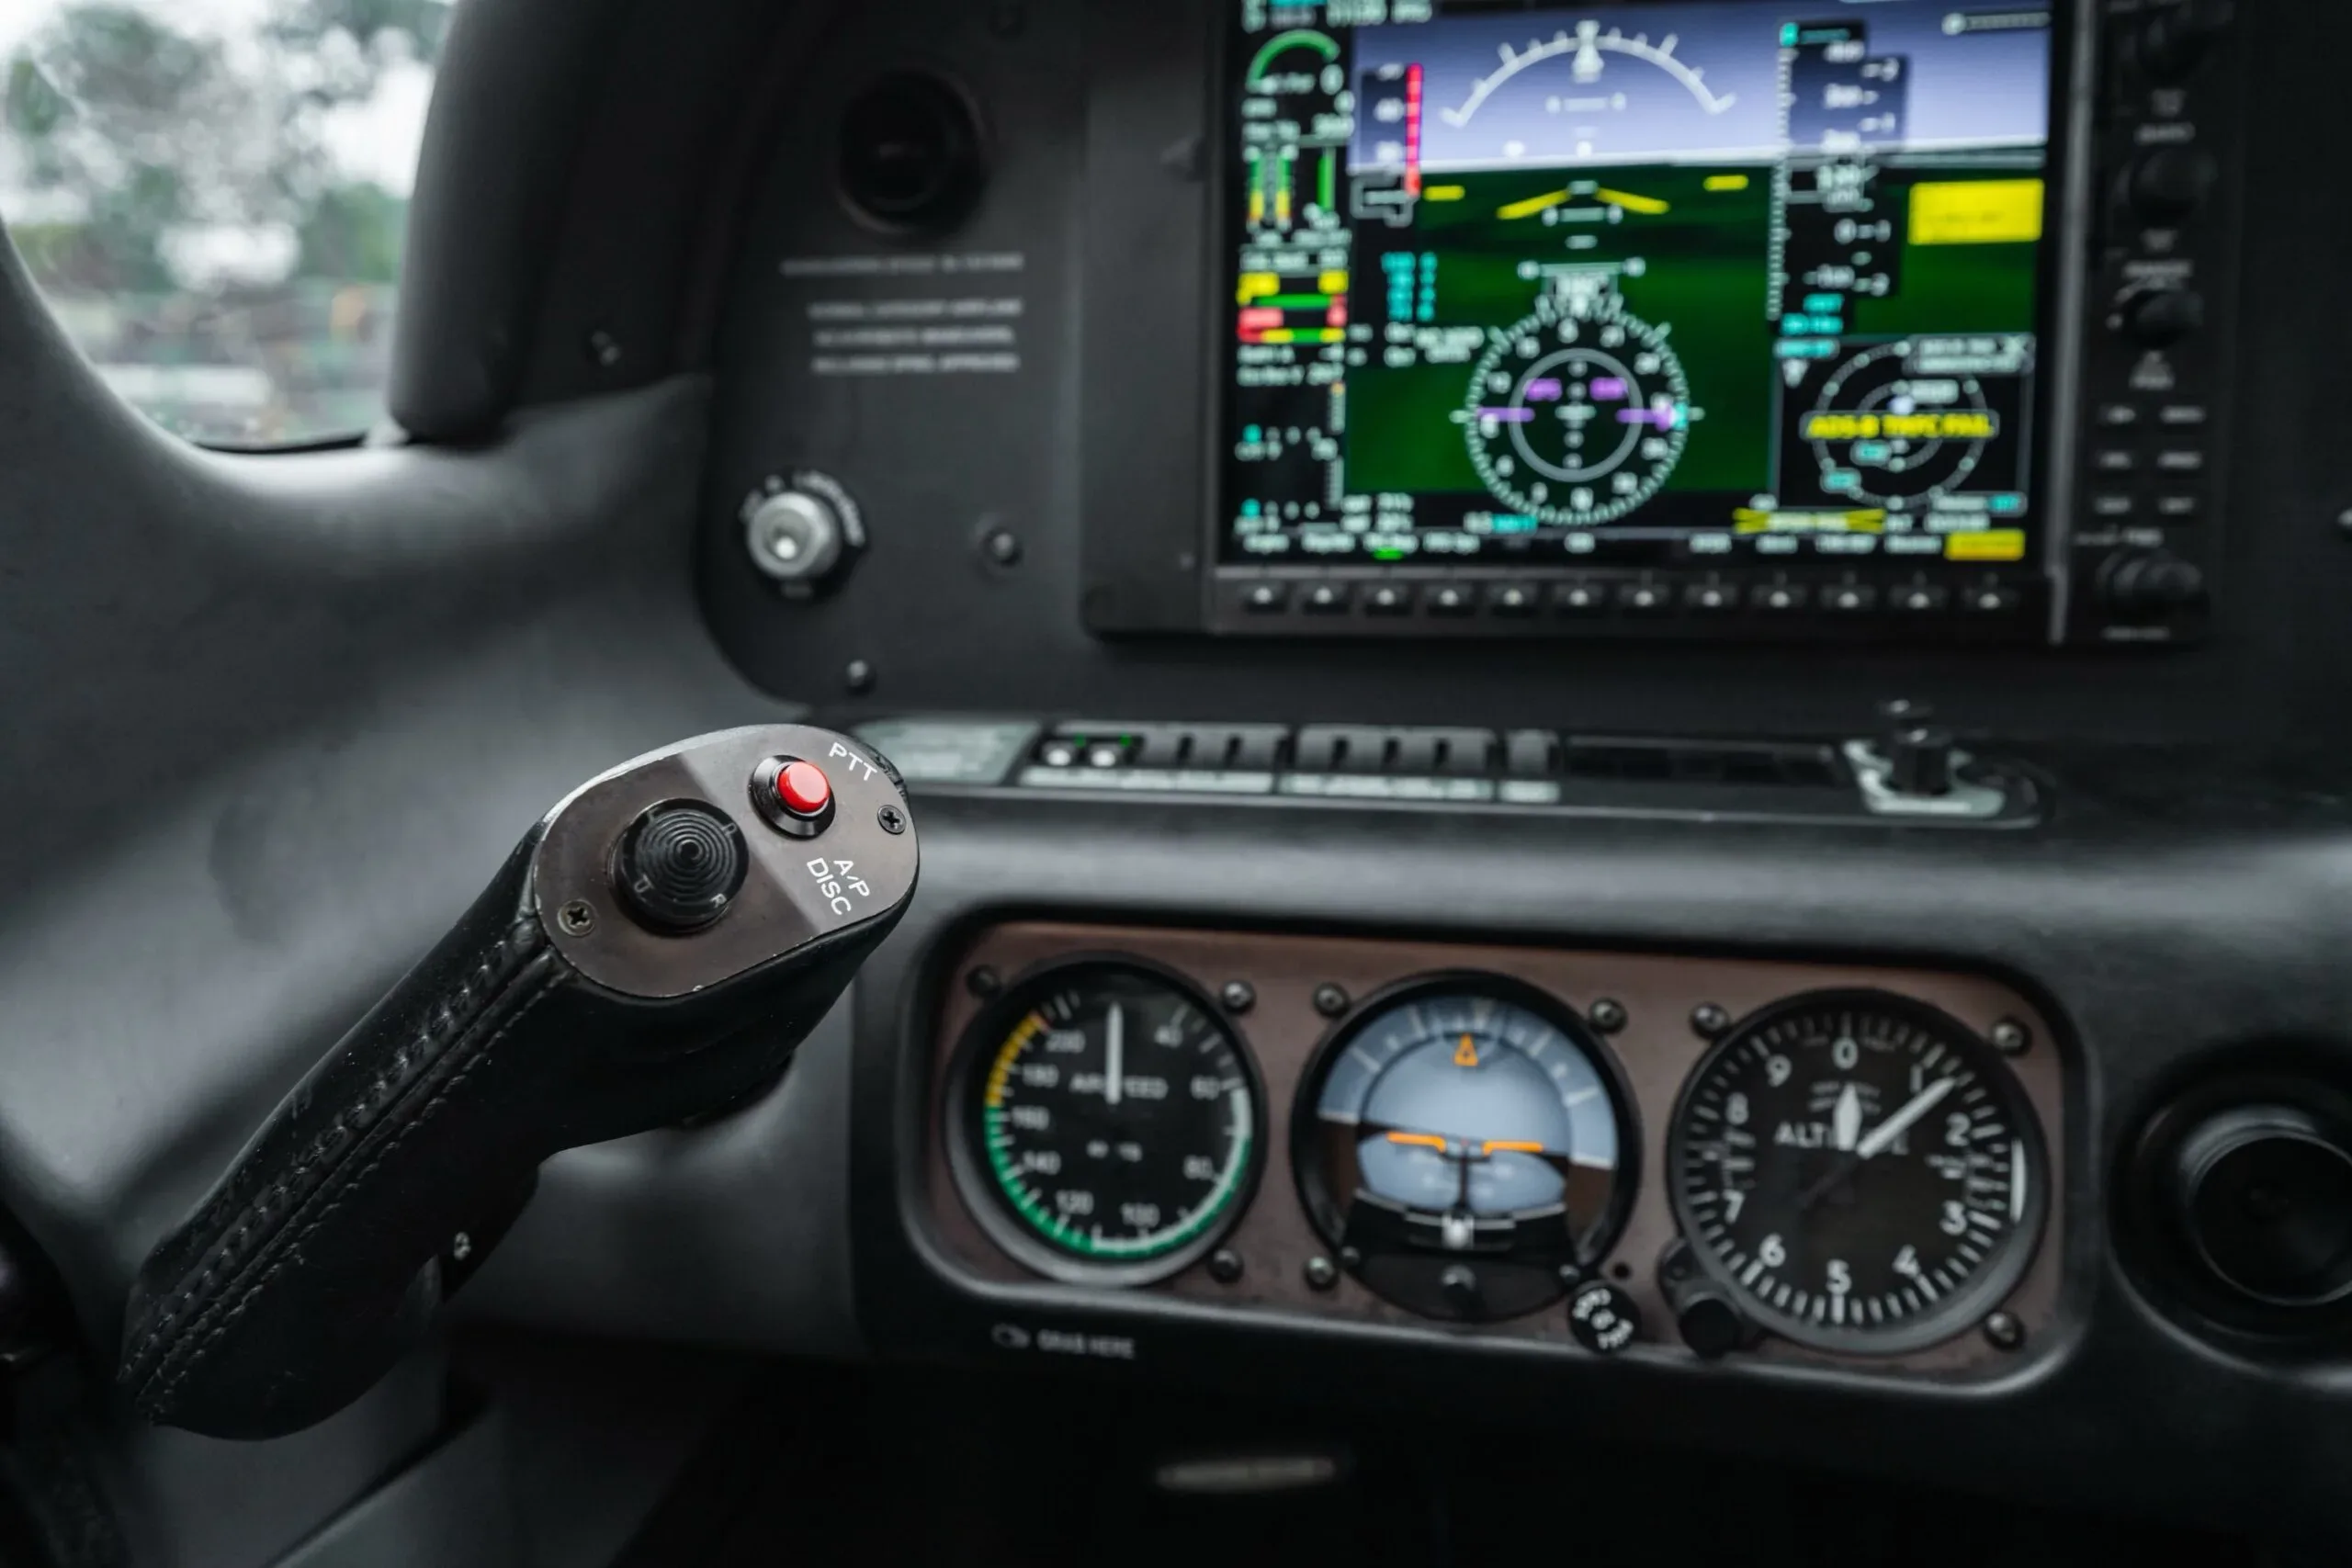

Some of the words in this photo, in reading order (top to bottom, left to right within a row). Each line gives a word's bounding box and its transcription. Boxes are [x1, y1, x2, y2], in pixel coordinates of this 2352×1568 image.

[829, 742, 877, 781] PTT
[807, 857, 852, 916] DISC
[833, 860, 870, 897] A/P
[1832, 1037, 1858, 1068] 0
[1765, 1055, 1792, 1087] 9
[1725, 1092, 1748, 1125] 8
[1945, 1112, 1971, 1146] 2
[1723, 1190, 1745, 1224] 7
[1939, 1201, 1968, 1235] 3
[1759, 1234, 1786, 1268] 6
[1893, 1245, 1921, 1276] 4
[1826, 1259, 1852, 1294] 5
